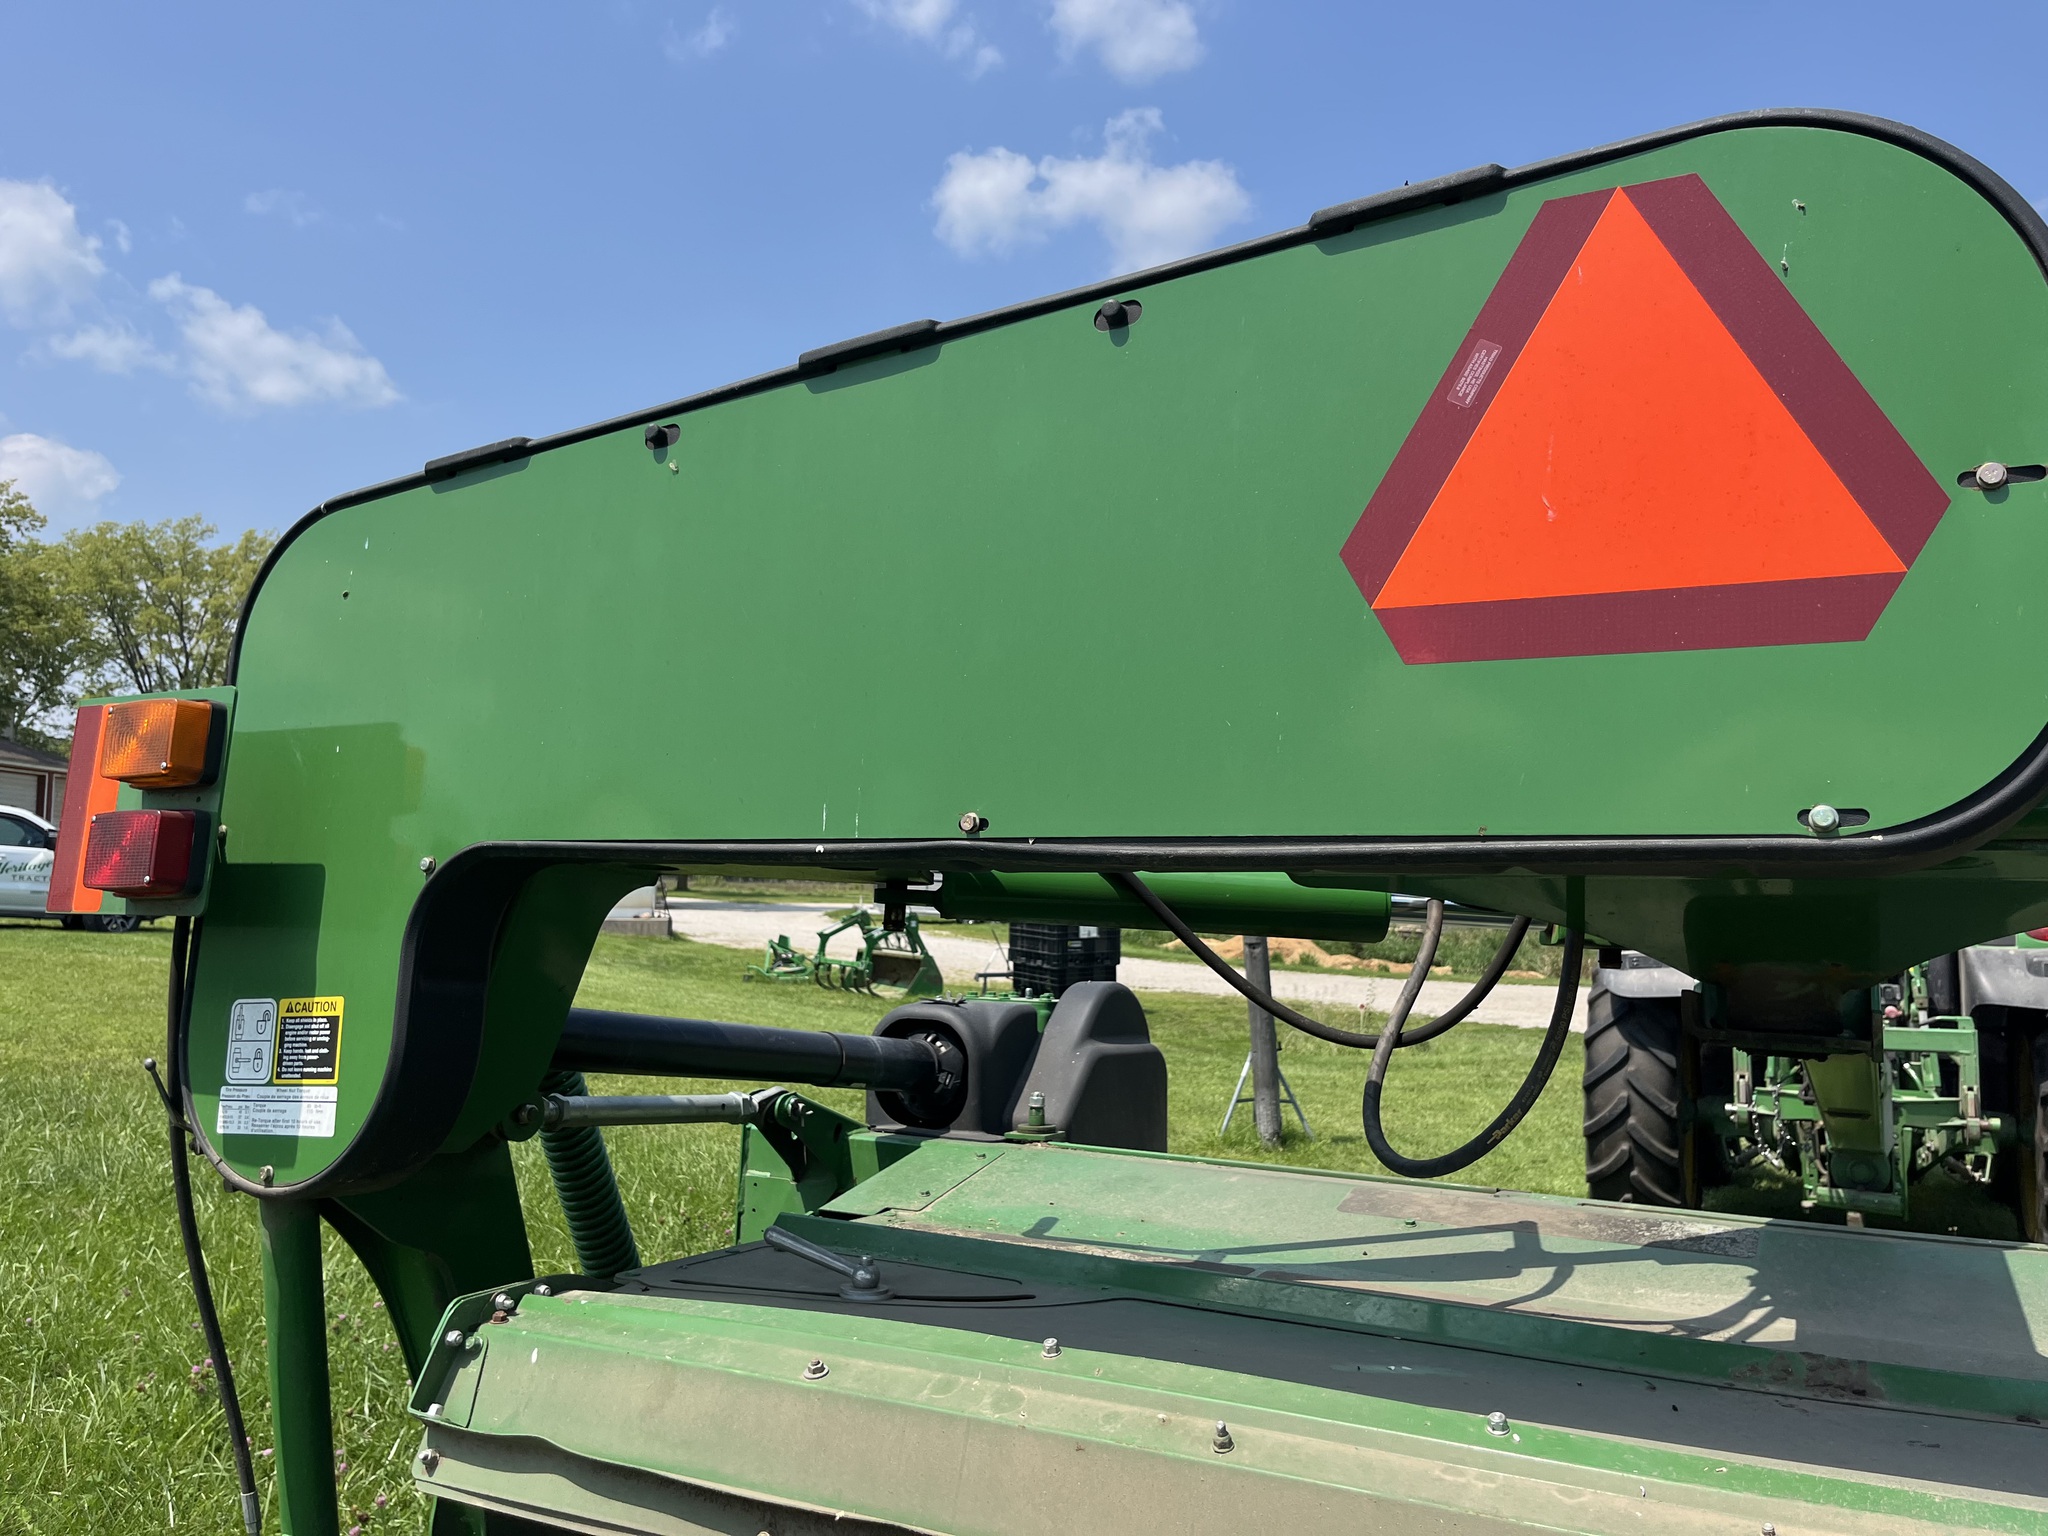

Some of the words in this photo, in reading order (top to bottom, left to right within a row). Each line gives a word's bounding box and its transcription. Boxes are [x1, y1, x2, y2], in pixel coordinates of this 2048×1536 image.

[1473, 350, 1487, 370] CERTIFIED
[1476, 361, 1491, 384] PRODUCTS
[1458, 370, 1475, 397] COMPLIANCE
[1465, 384, 1478, 404] COMPANY
[295, 1002, 337, 1013] CAUTION
[1487, 1108, 1522, 1144] Parker
